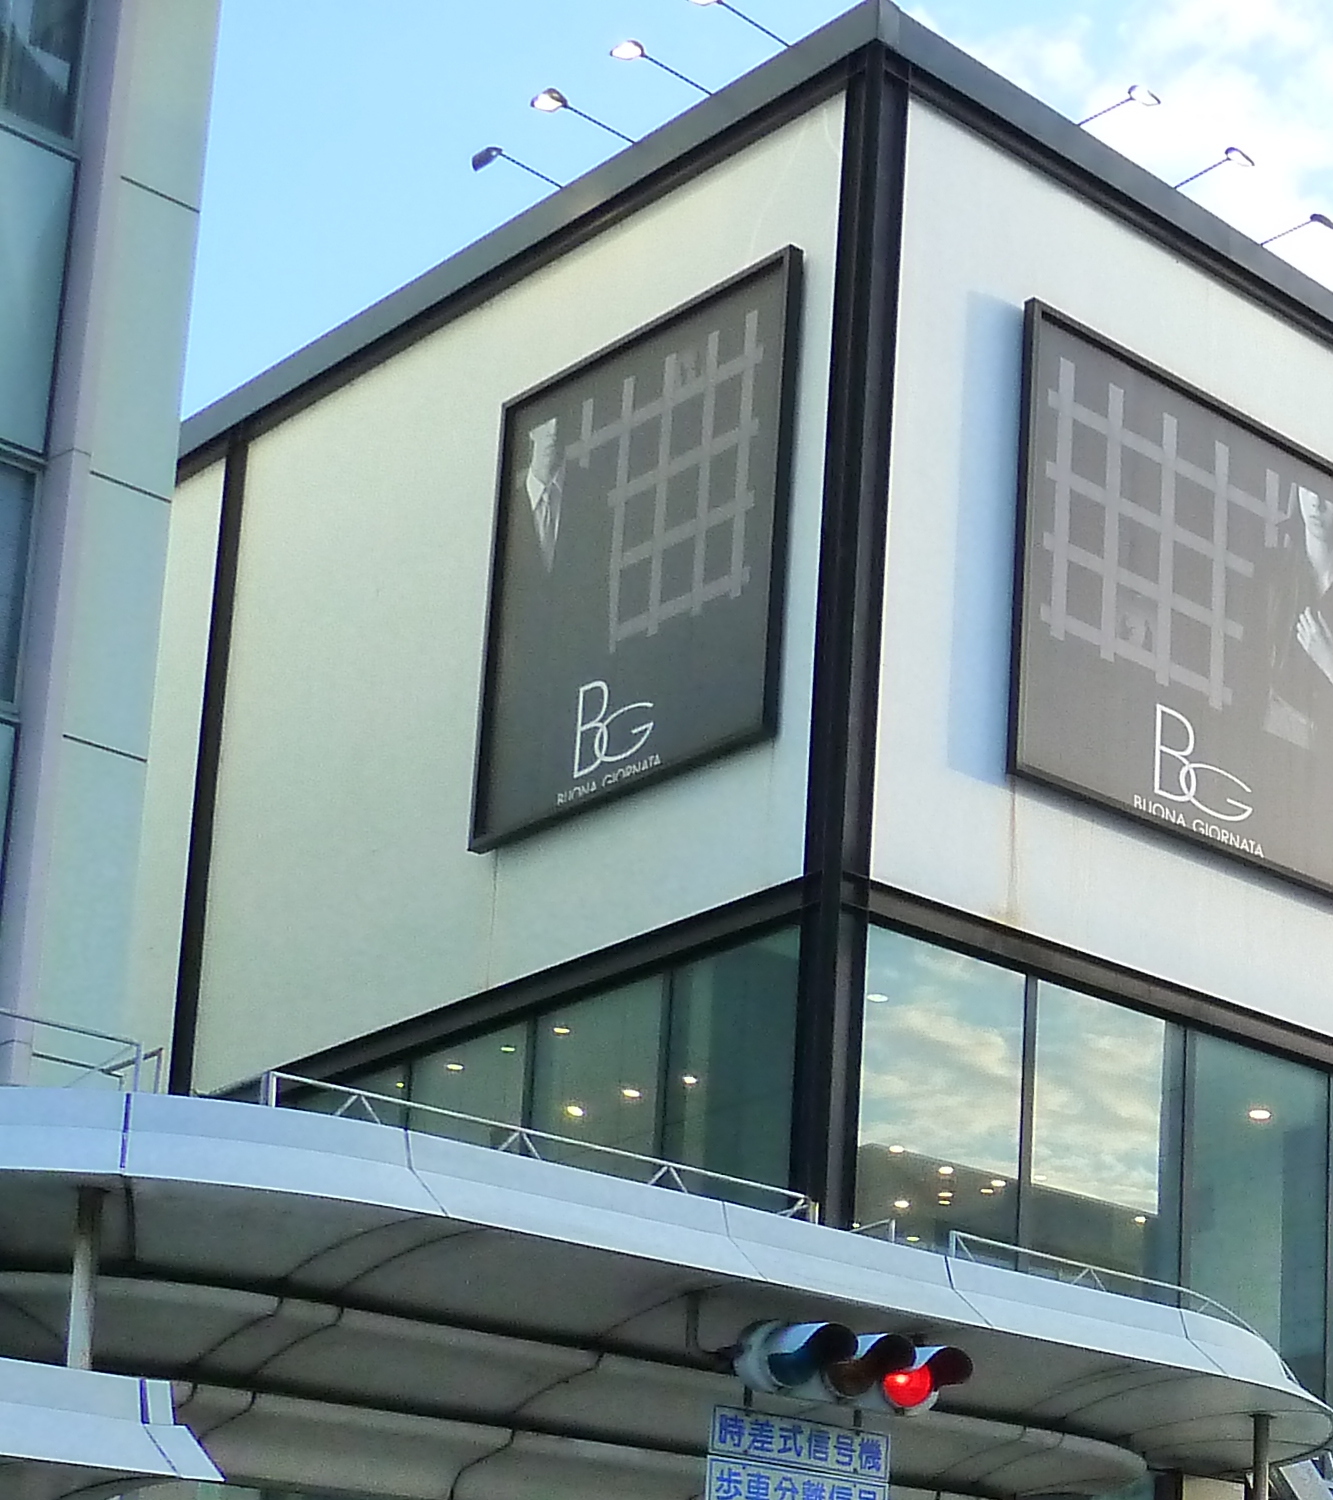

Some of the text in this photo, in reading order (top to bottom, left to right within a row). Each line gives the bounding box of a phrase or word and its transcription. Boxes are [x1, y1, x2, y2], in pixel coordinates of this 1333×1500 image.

[573, 679, 655, 779] BG
[602, 753, 662, 788] GIORNATA
[1154, 703, 1254, 822] BG
[1133, 793, 1265, 859] BUONA GIORNATA
[717, 1413, 883, 1473] 時差式信号機
